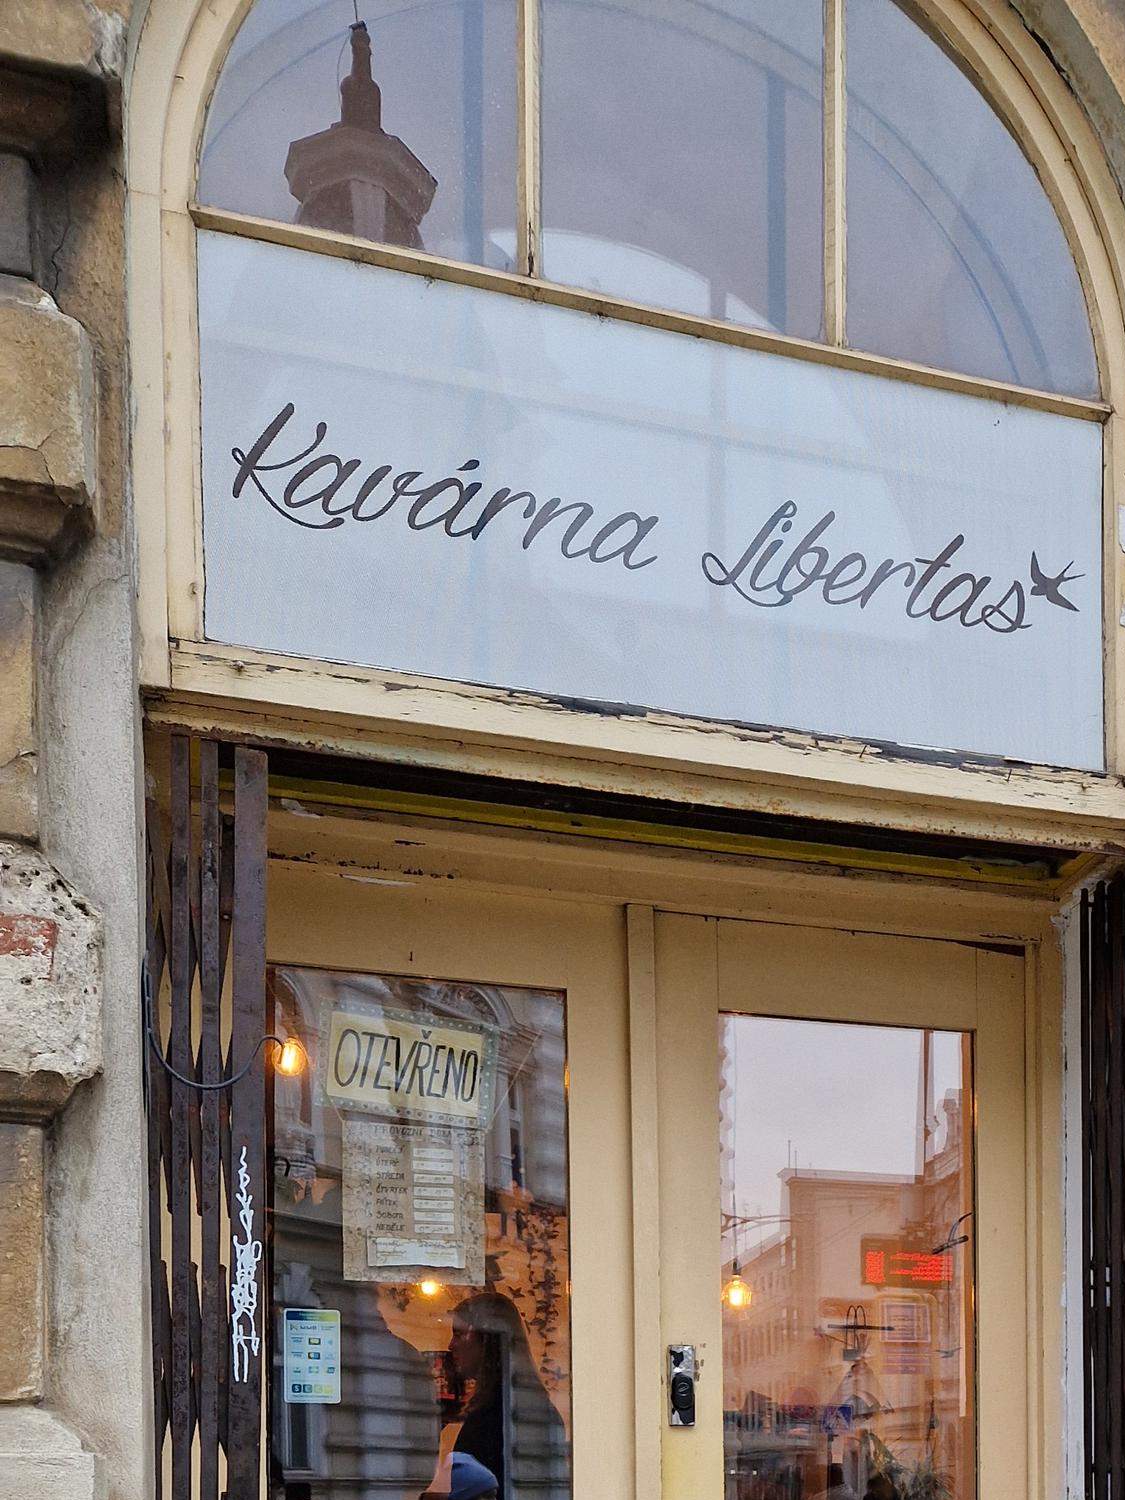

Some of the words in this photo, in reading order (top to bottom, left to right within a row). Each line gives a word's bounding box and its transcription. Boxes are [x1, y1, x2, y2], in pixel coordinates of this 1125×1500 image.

[230, 401, 658, 571] Kavárna
[702, 500, 1031, 634] Libertas
[333, 1029, 480, 1103] OTEVŘENO
